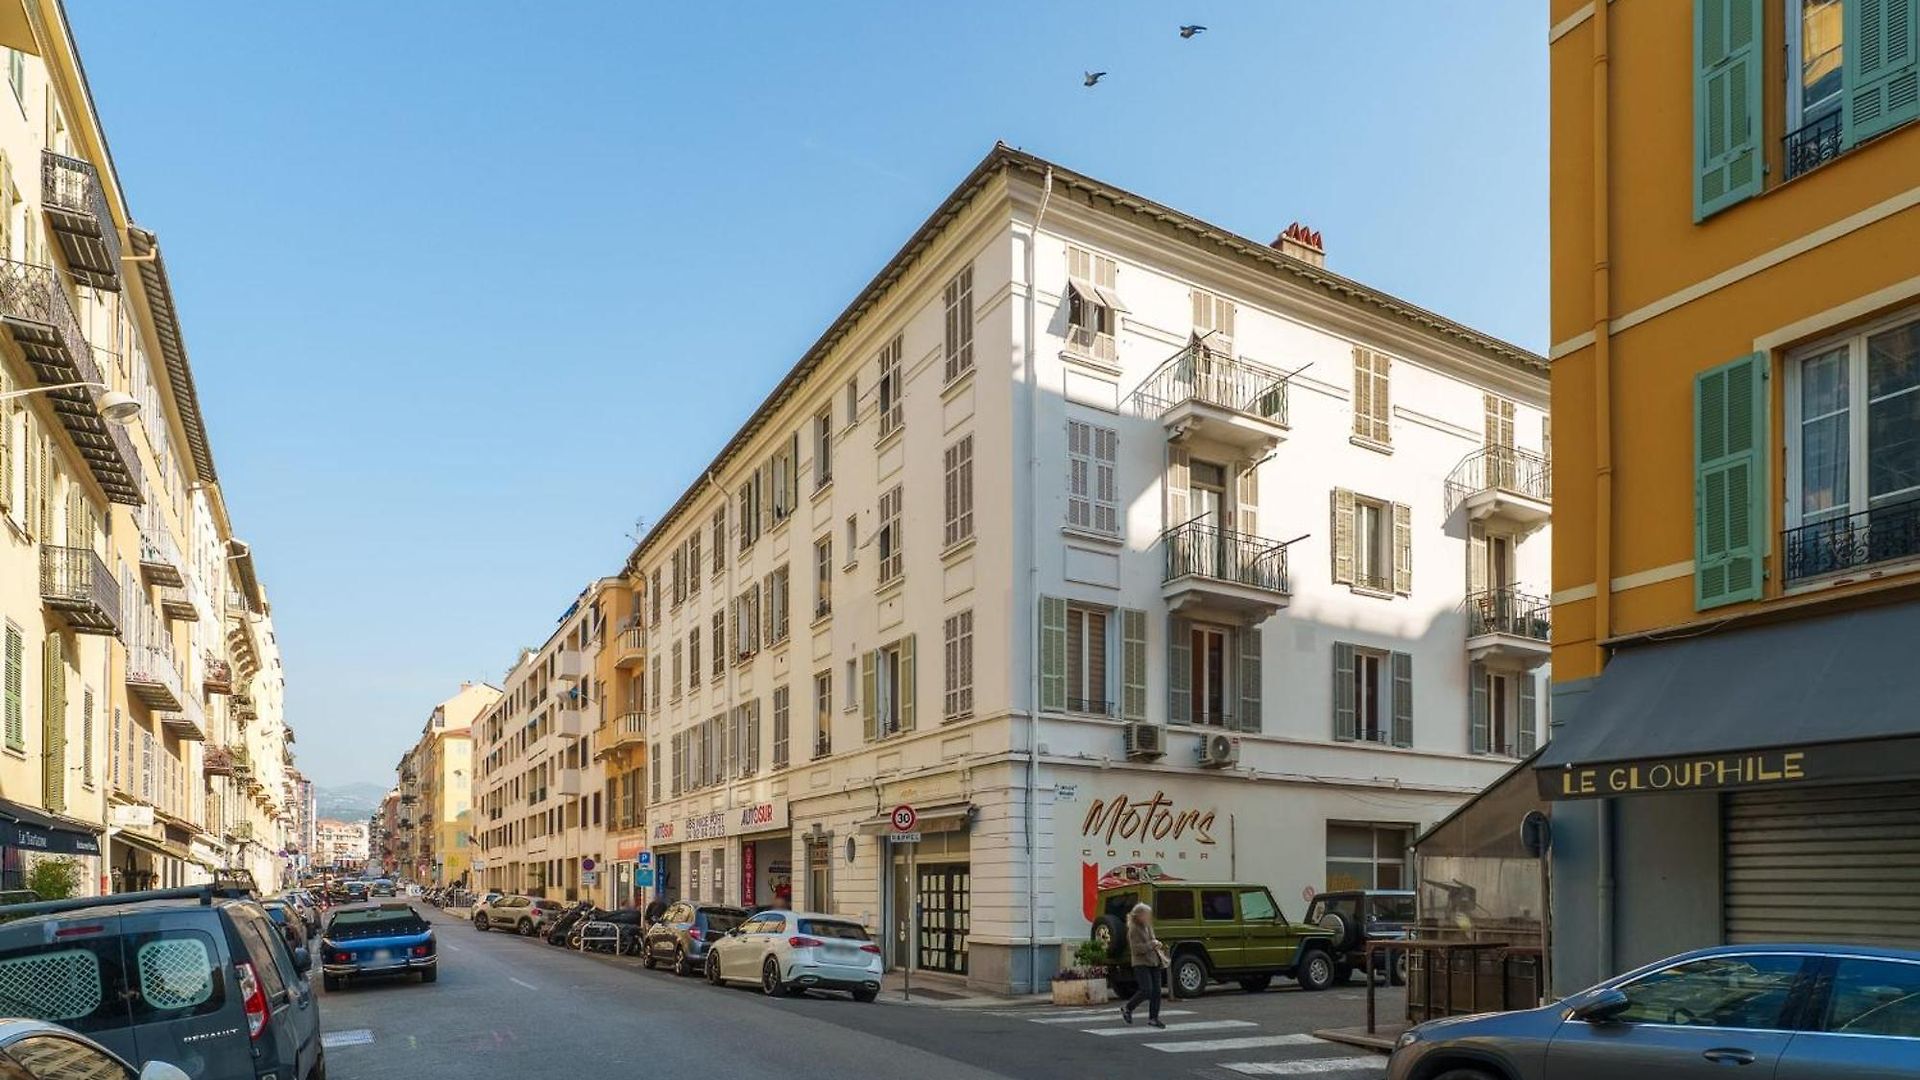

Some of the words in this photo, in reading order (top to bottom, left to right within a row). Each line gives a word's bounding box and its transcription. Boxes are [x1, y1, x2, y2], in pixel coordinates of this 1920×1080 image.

[1563, 770, 1596, 794] LE
[1609, 752, 1804, 791] GLOUPHILE
[741, 804, 773, 826] AUTOSUR
[897, 813, 911, 824] 30
[1082, 790, 1216, 845] Motors
[1082, 848, 1209, 860] CORNER
